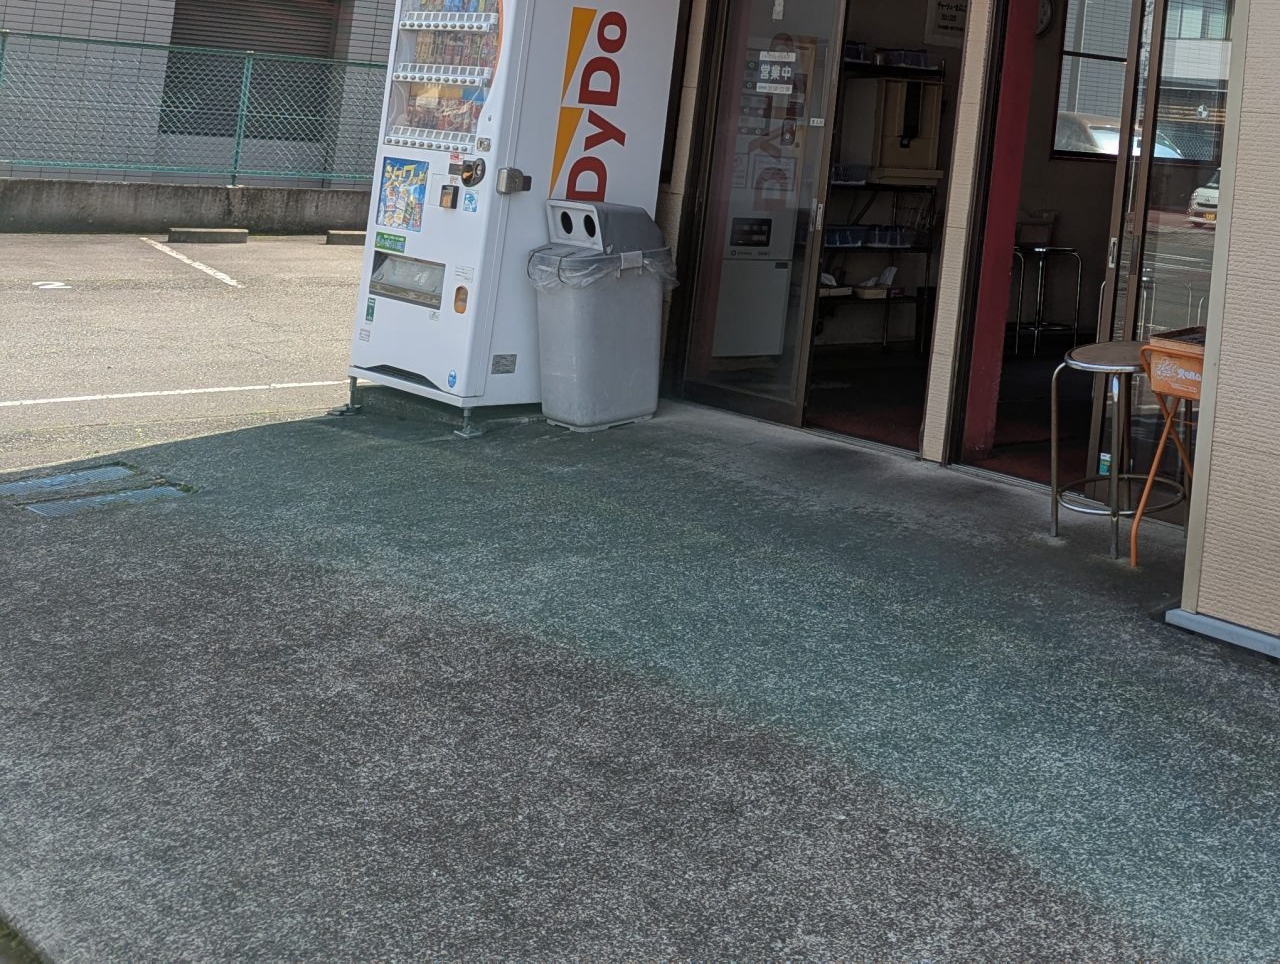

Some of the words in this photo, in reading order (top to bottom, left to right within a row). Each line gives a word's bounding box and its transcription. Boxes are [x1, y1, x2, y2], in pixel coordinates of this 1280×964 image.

[566, 11, 628, 203] DyDo
[760, 63, 792, 81] 営業中
